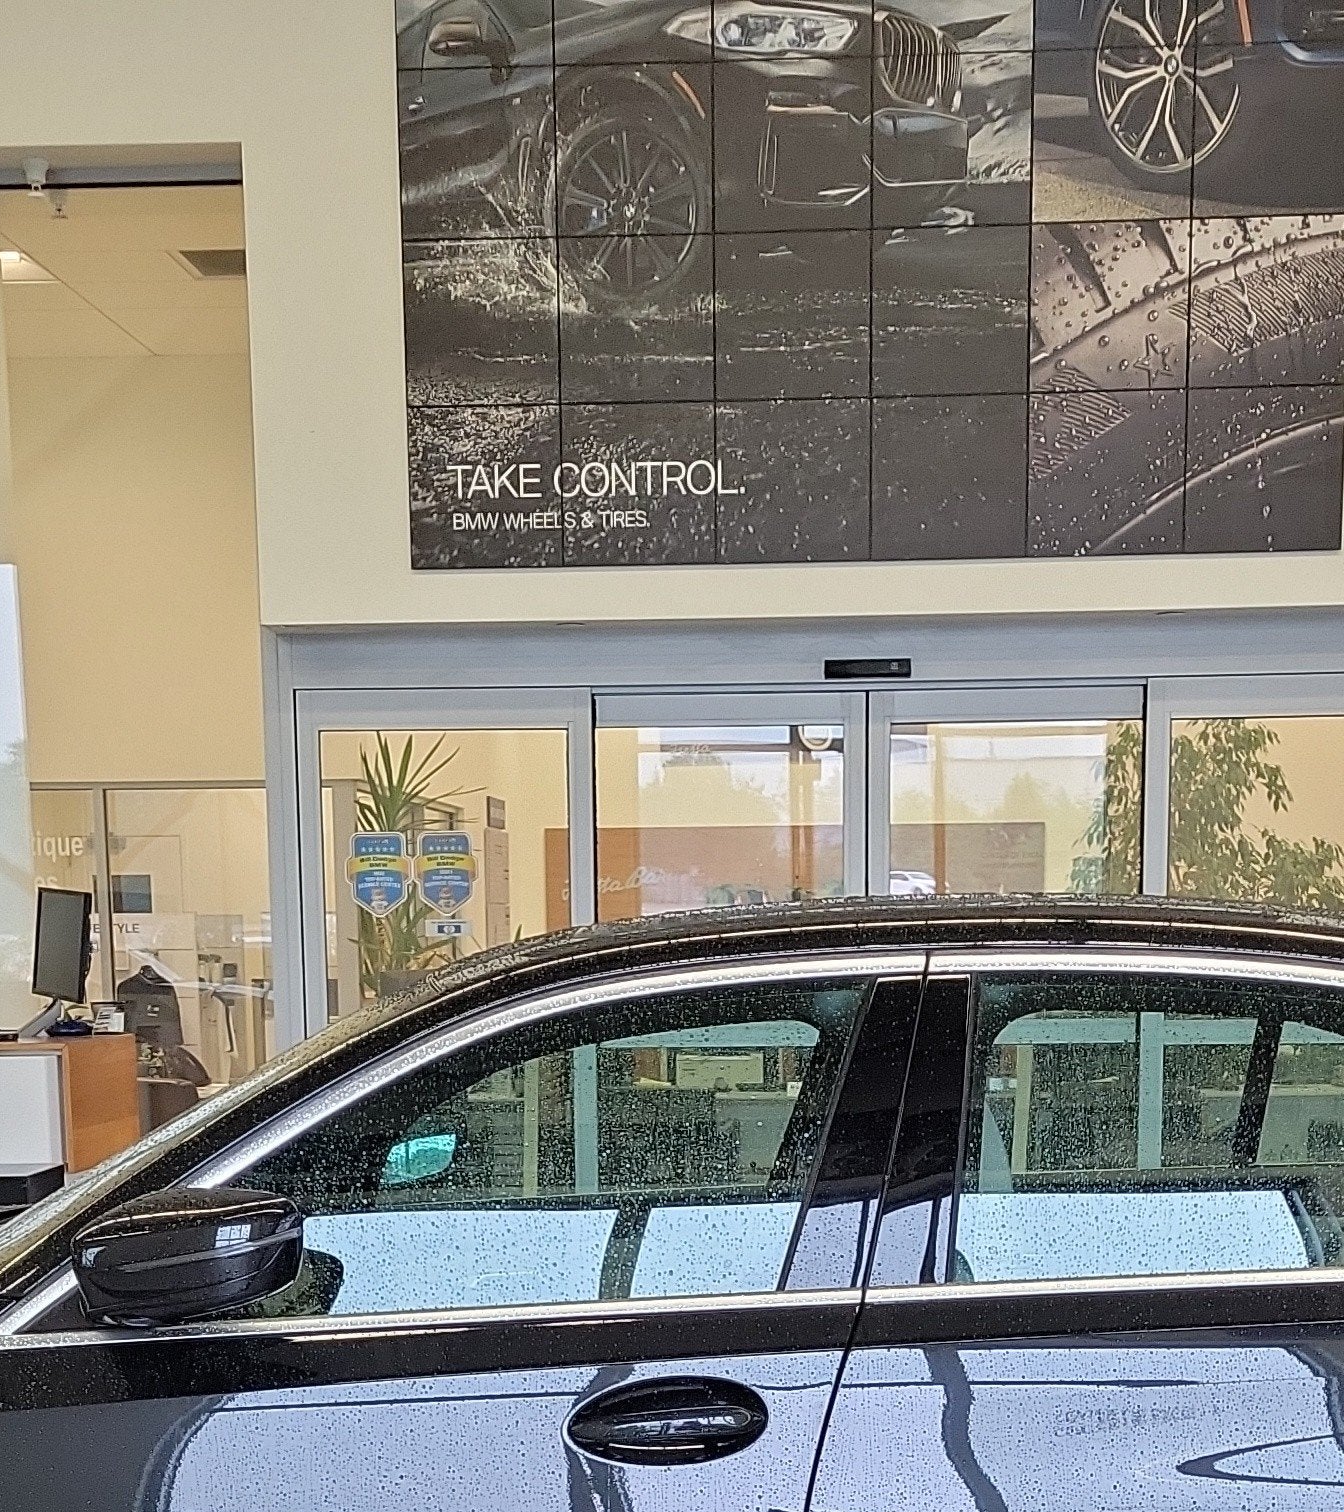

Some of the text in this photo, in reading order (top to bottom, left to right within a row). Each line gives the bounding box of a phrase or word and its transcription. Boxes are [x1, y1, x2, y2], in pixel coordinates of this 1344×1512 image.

[446, 459, 746, 500] TAKE CONTROL.
[452, 510, 651, 530] BMW WHEELS & TIRES.
